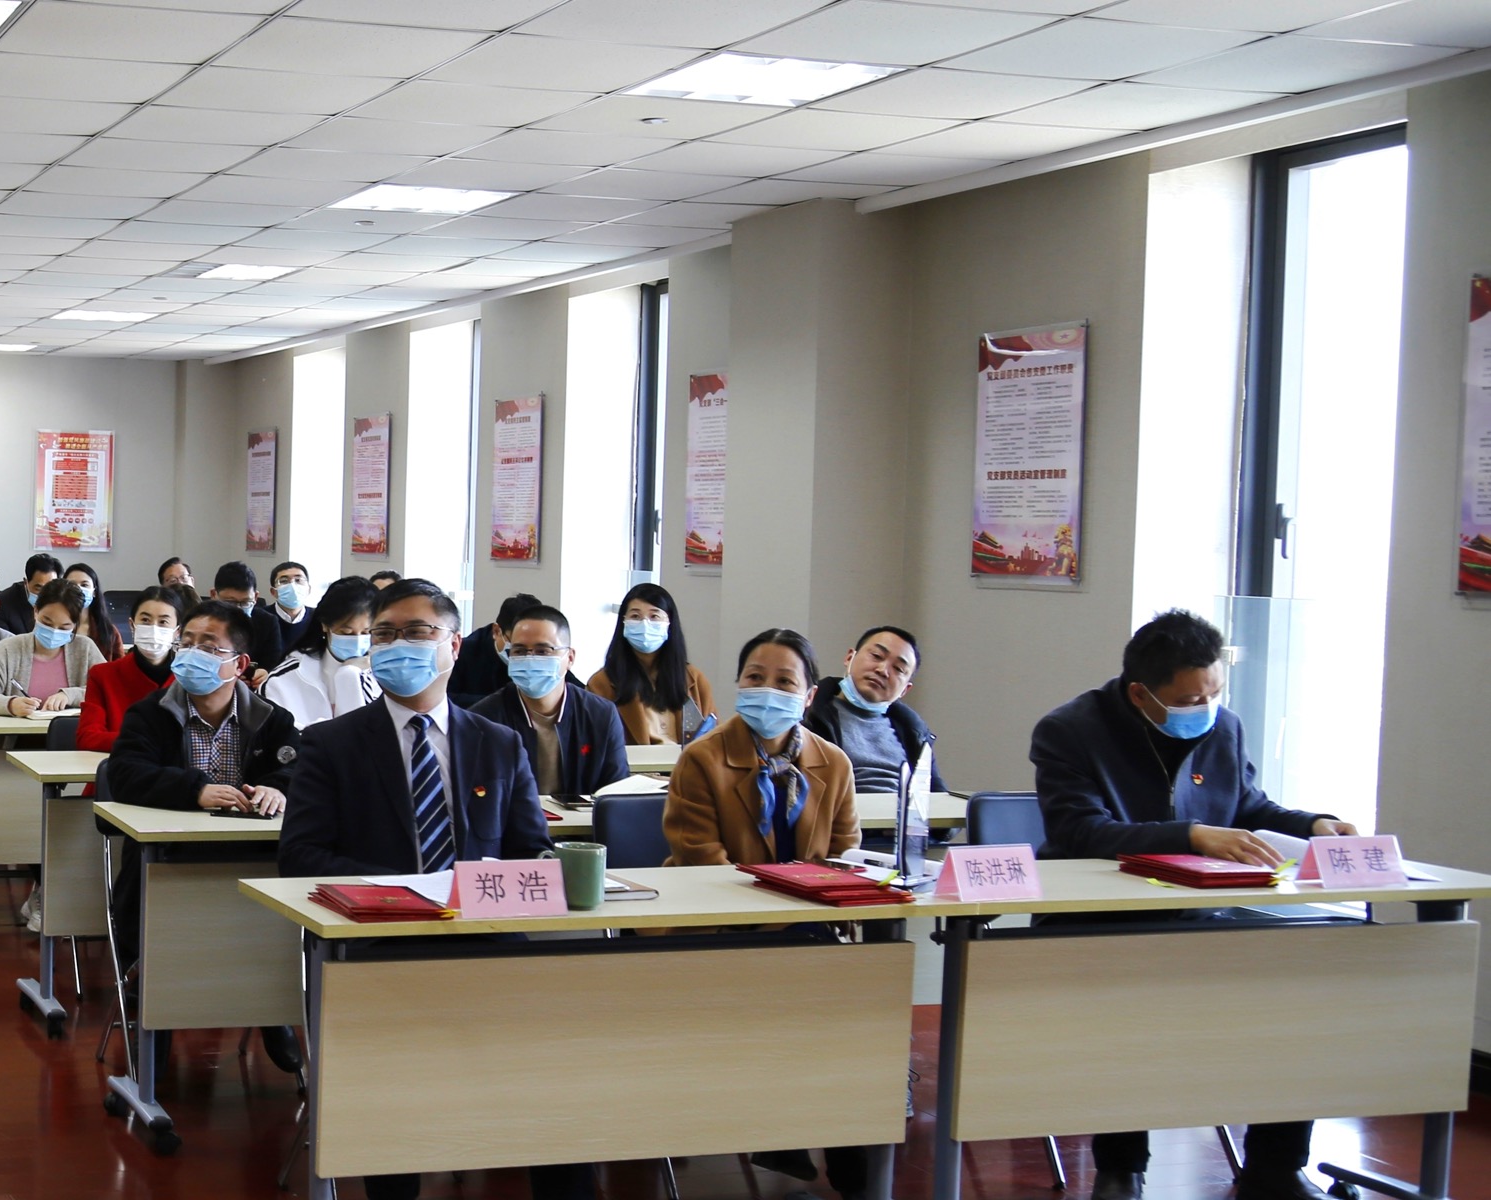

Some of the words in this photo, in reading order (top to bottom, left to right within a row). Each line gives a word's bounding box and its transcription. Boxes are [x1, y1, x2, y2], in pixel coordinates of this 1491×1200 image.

[965, 857, 1027, 887] 陈洪琳
[1327, 846, 1389, 874] 陈建
[475, 870, 548, 903] 郑浩
